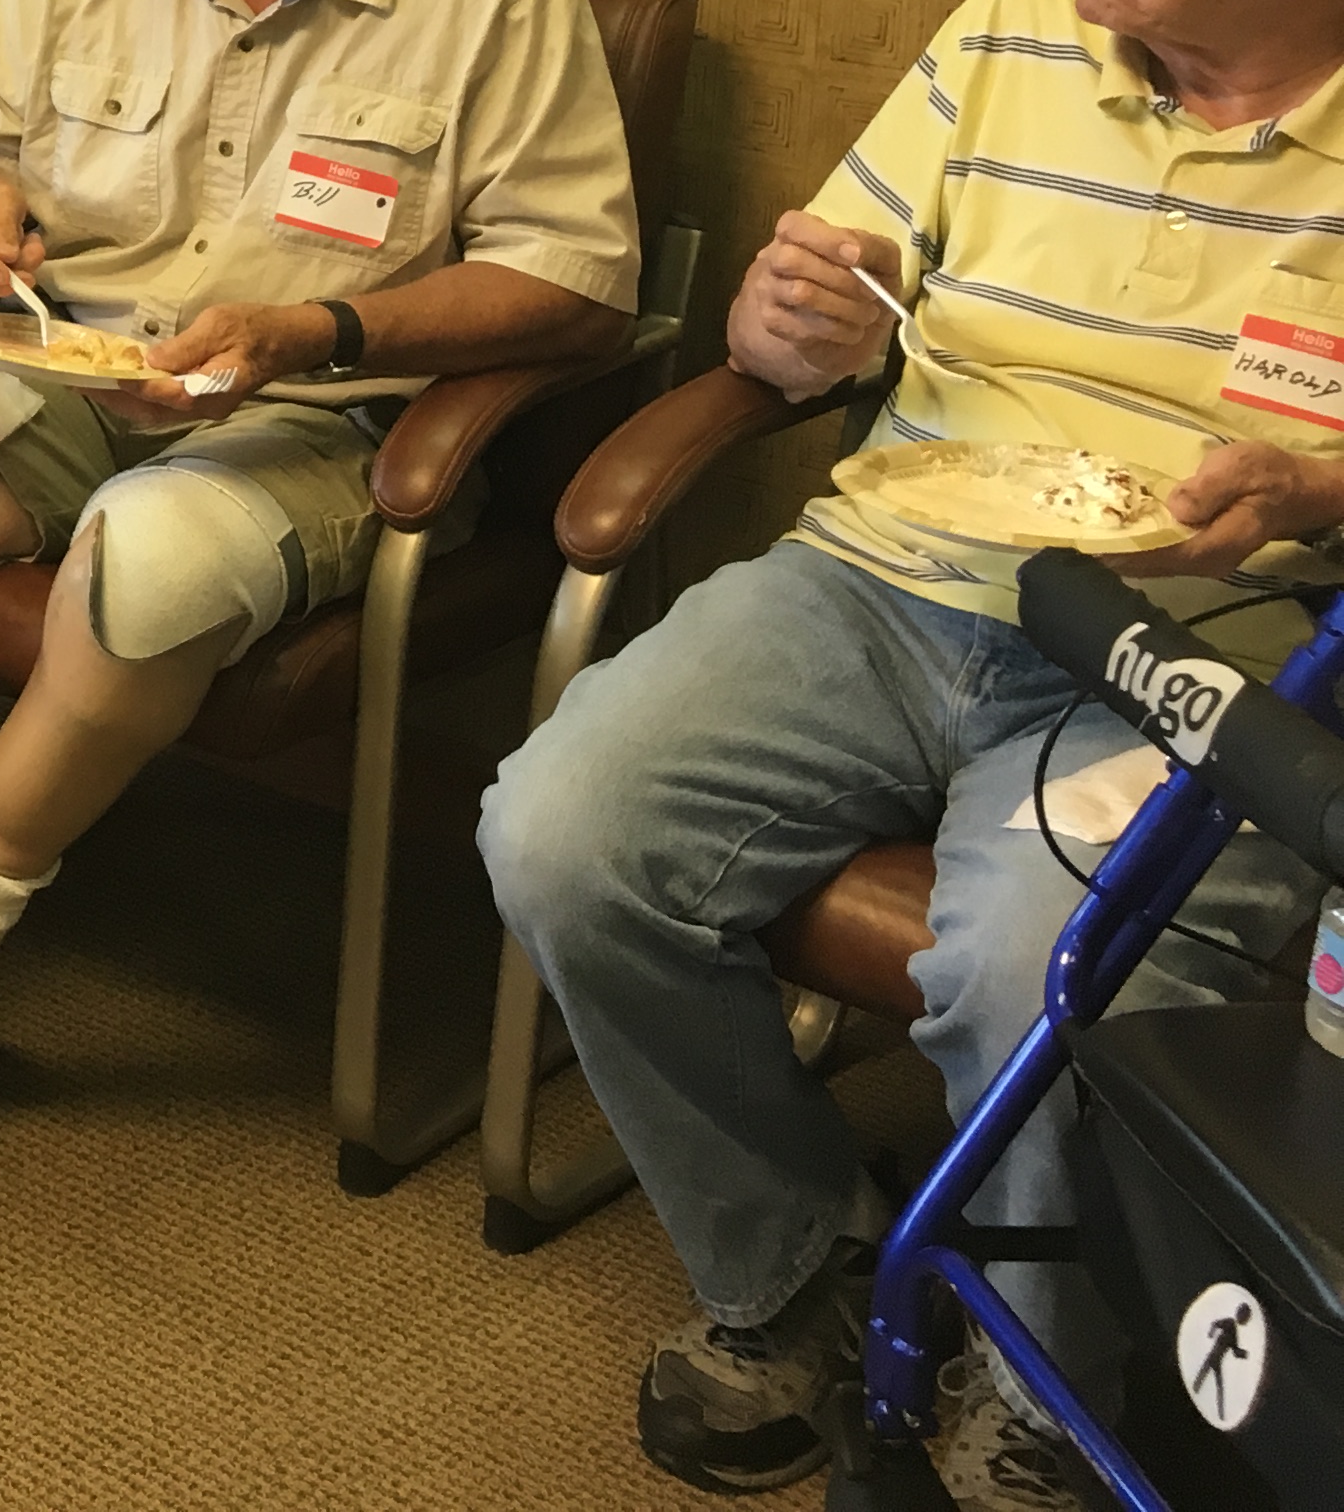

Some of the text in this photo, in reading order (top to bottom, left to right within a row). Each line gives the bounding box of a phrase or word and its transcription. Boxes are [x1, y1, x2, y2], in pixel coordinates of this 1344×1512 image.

[328, 162, 361, 180] Hello
[291, 181, 341, 207] Bill
[1293, 329, 1335, 350] Hello
[1234, 352, 1343, 398] HAROLD
[1104, 621, 1223, 739] hugo
